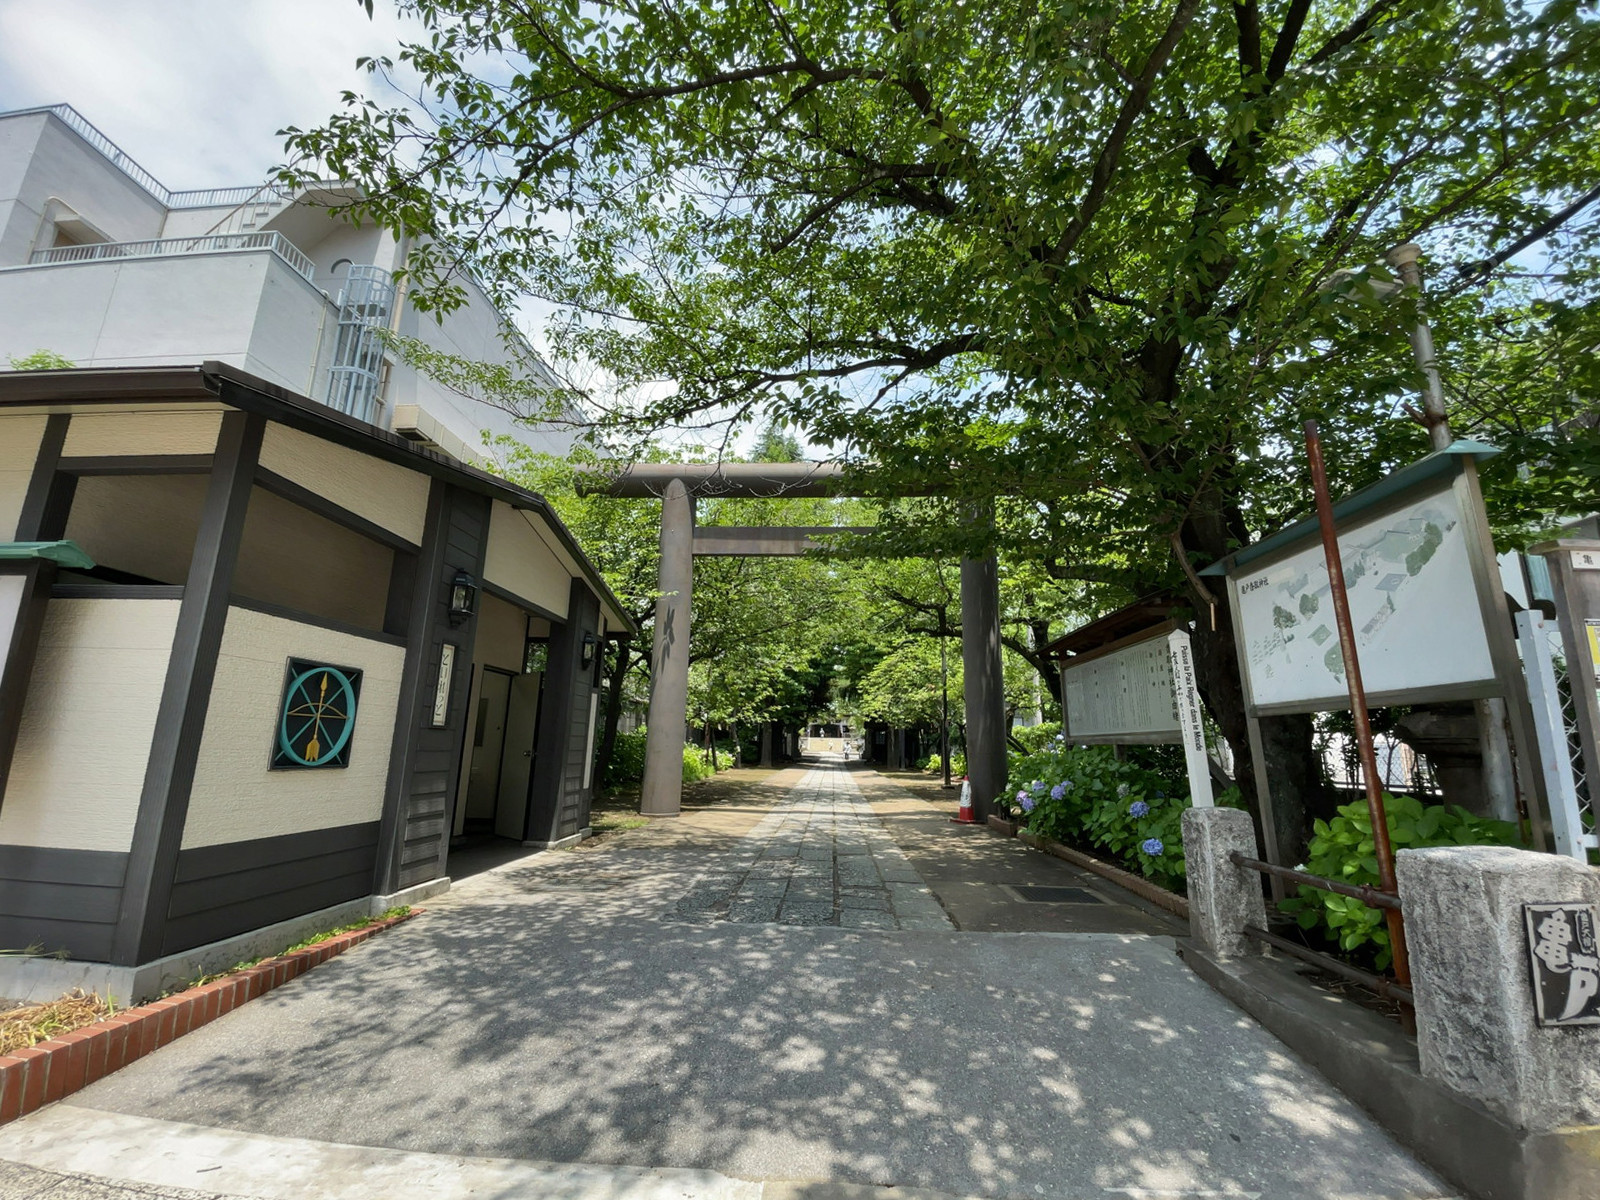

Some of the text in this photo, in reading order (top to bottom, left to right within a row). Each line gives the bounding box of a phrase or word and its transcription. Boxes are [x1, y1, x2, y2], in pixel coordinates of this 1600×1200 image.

[434, 653, 450, 717] といれっと
[1185, 672, 1193, 686] Paix
[1190, 708, 1198, 724] dans
[1194, 731, 1204, 752] Monde
